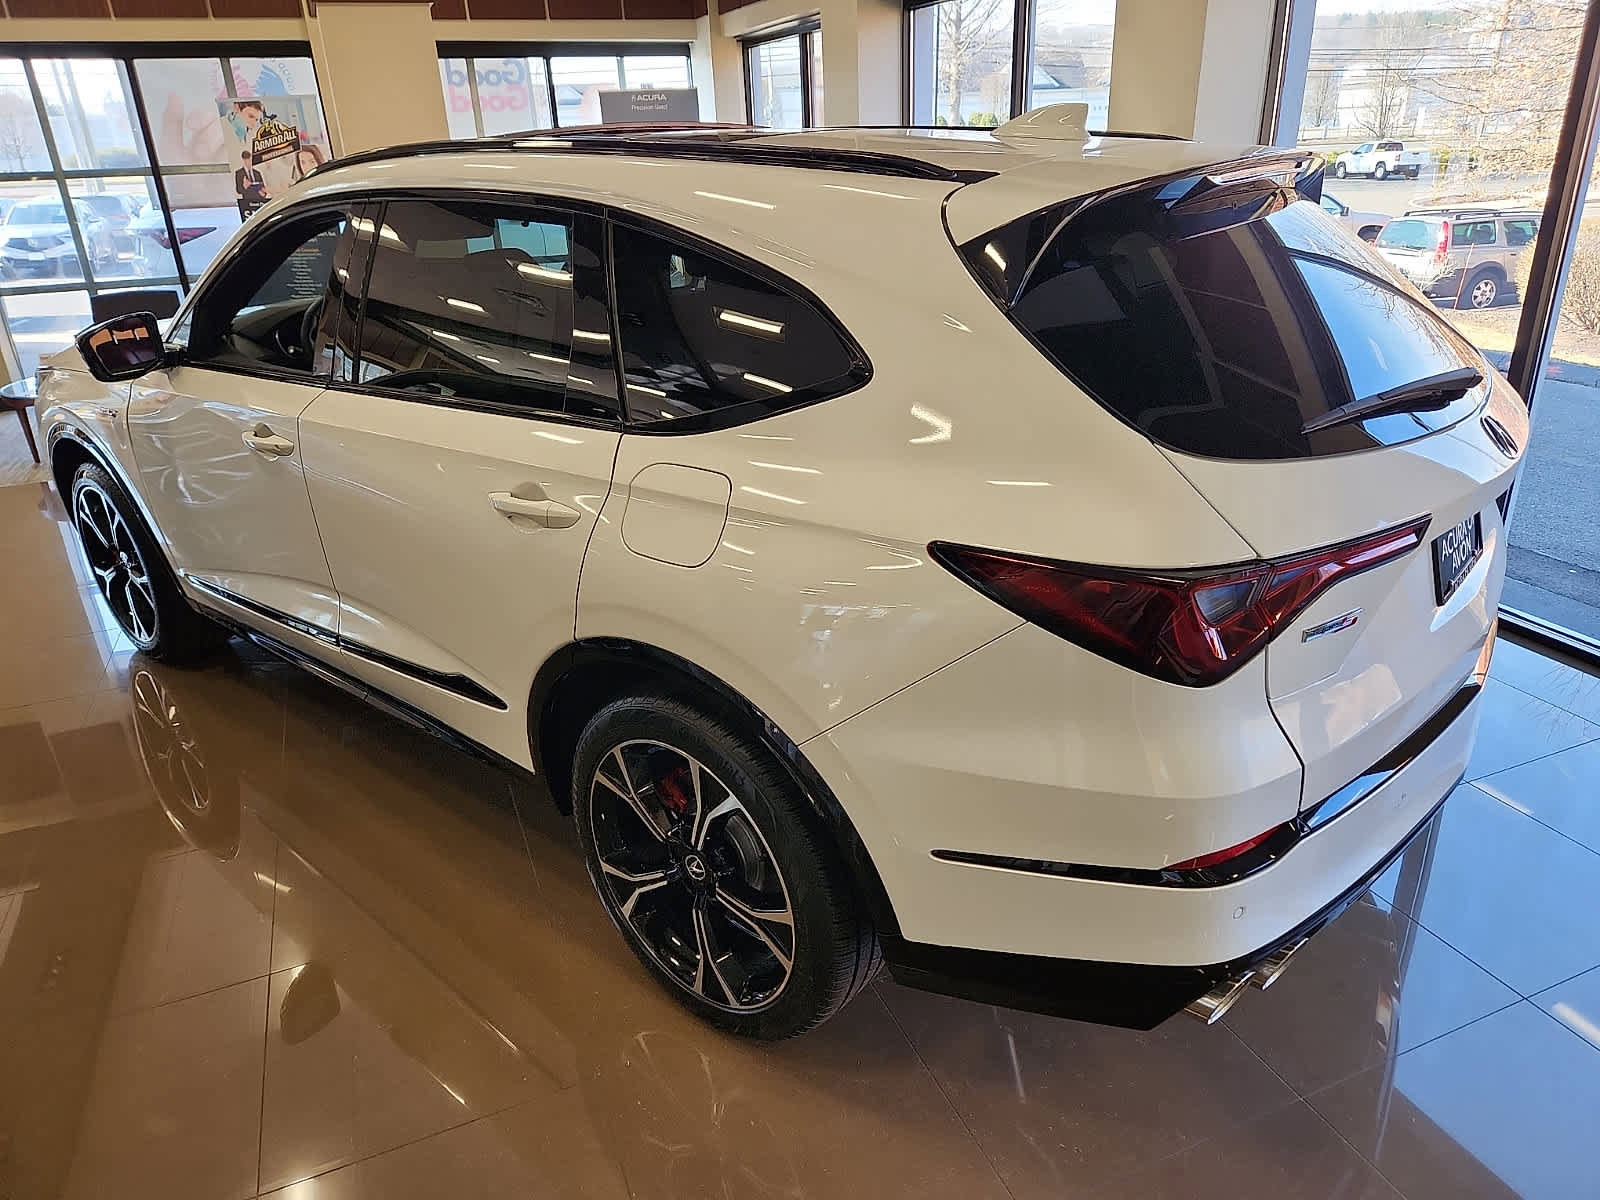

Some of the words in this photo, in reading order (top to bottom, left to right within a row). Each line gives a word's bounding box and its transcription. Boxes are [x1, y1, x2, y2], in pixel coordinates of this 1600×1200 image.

[637, 93, 667, 101] ACURA
[1441, 519, 1467, 562] ACURA
[1451, 532, 1472, 574] AVON
